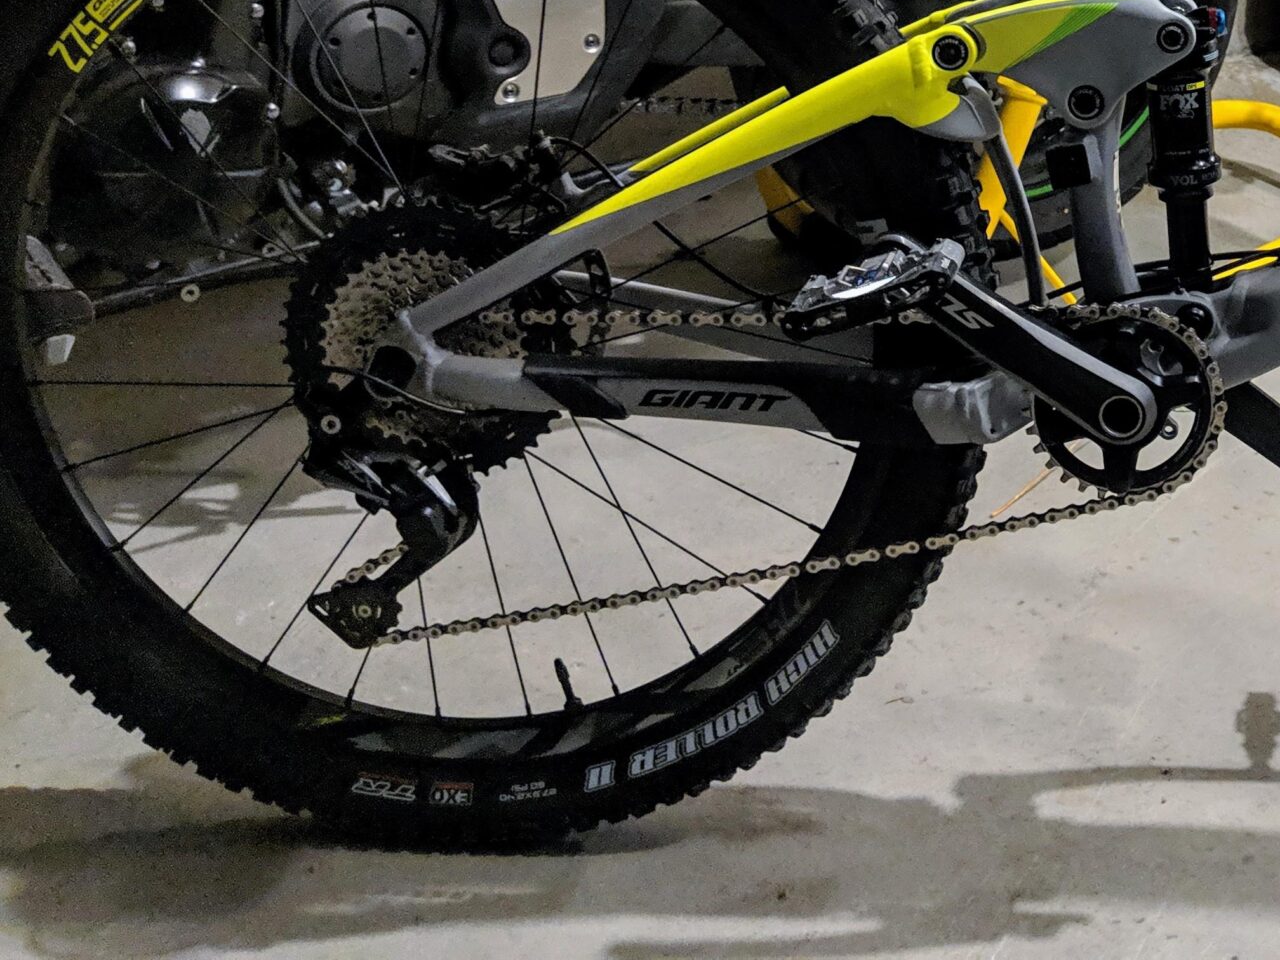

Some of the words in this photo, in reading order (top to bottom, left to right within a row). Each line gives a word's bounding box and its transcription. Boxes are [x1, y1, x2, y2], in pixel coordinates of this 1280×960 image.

[49, 8, 110, 74] 27.5
[1159, 92, 1200, 111] FOX
[638, 389, 792, 412] GIANT
[763, 619, 841, 706] HIGH
[627, 691, 763, 779] ROLLER
